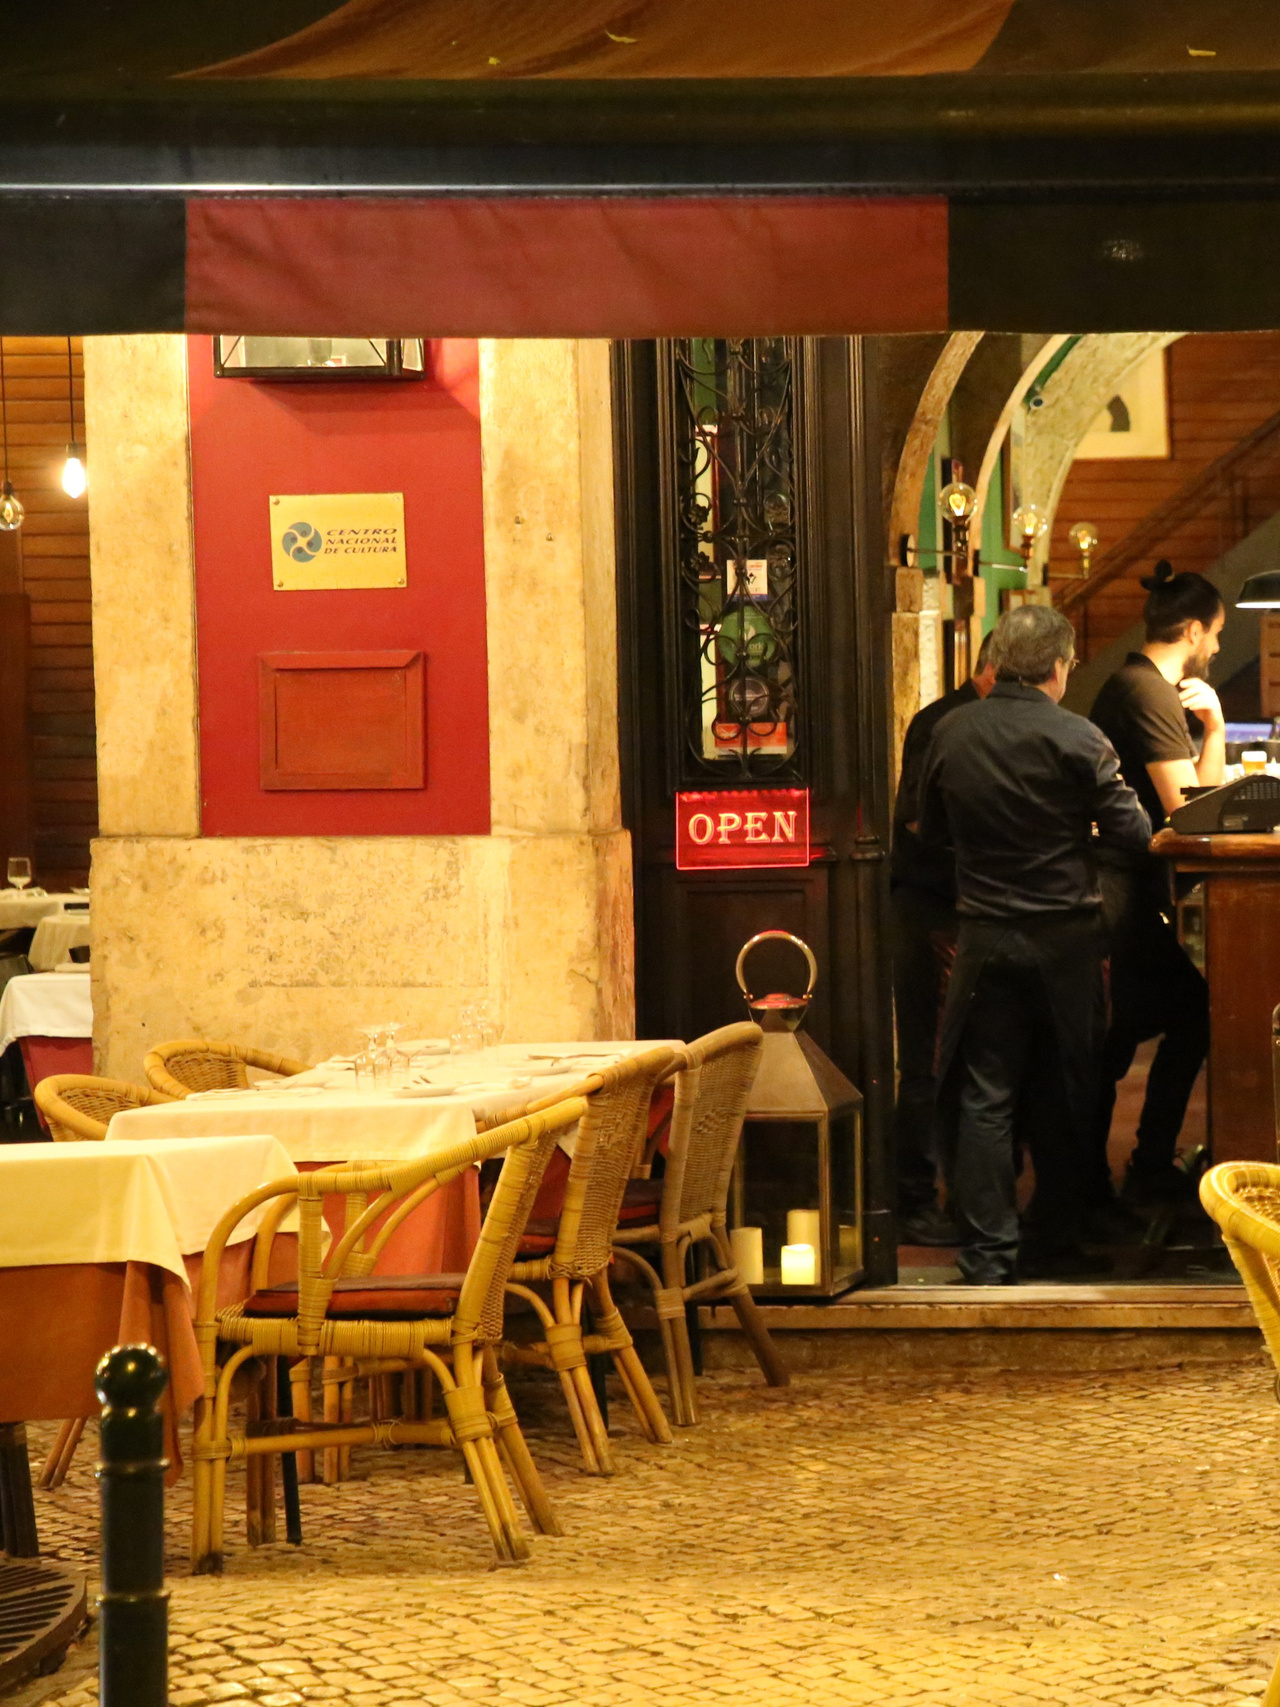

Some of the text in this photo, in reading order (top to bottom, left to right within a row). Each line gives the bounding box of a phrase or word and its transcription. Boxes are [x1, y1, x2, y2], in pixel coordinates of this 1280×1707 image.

[326, 528, 397, 536] CENTRO
[326, 537, 397, 545] NACIONAL
[324, 546, 397, 555] DE CULTURA
[688, 811, 798, 846] OPEN
